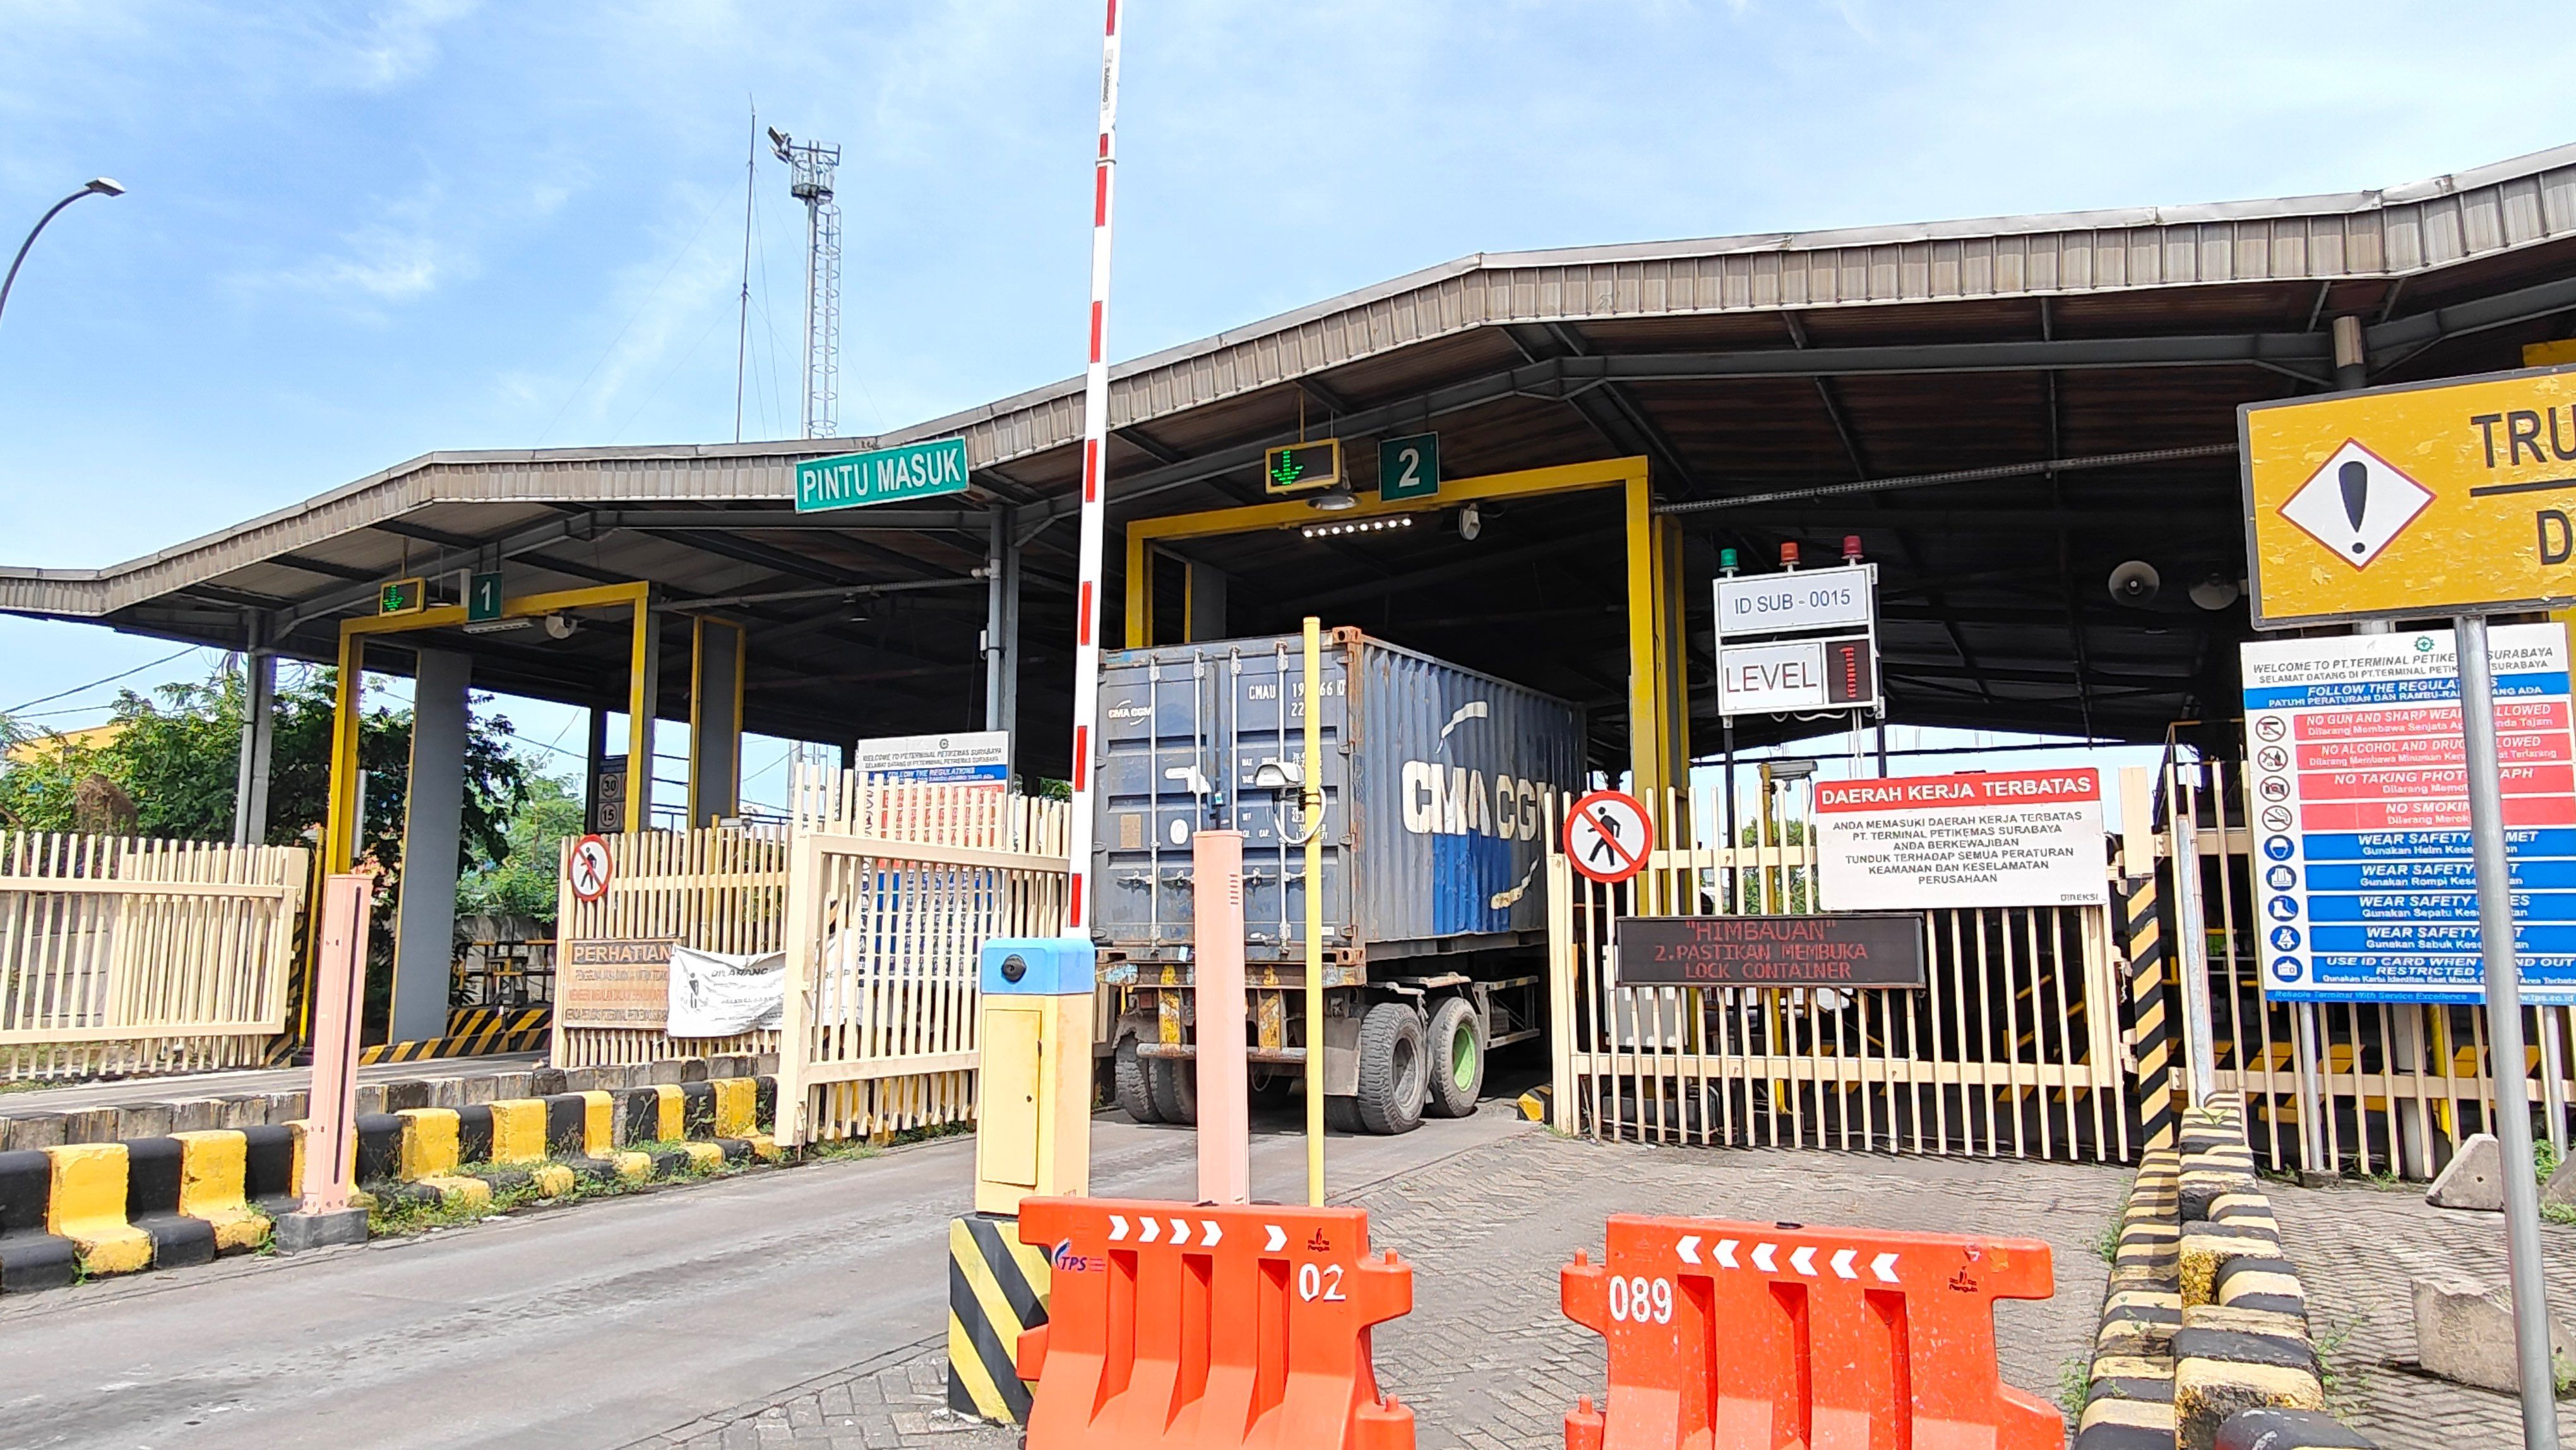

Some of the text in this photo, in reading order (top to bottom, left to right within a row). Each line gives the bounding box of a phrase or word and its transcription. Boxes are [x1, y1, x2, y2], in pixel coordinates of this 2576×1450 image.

[2471, 404, 2576, 468] TRU
[802, 448, 961, 503] PINTU MASUK
[1398, 448, 1420, 488] 2
[2536, 509, 2573, 565] D
[481, 581, 491, 611] 1
[1735, 597, 1751, 614] ID
[1756, 594, 1793, 612] SUB
[1810, 589, 1851, 608] 0015
[2253, 661, 2311, 673] WELCOME
[2313, 661, 2330, 670] TO
[2412, 652, 2455, 664] PETIKE
[2488, 647, 2553, 660] SURABAYA
[1726, 661, 1817, 693] LEVEL
[1839, 645, 1857, 698] 1
[2259, 673, 2304, 684] SELAMAT
[2306, 672, 2346, 681] DATANG
[2429, 665, 2459, 674] PETIK
[2491, 660, 2548, 671] SURABAYA
[1249, 684, 1277, 700] CMAU
[1292, 681, 1333, 697] 1966
[2307, 684, 2365, 697] FOLLOW
[2369, 683, 2396, 693] THE
[2269, 698, 2305, 707] PATUHI
[2374, 693, 2396, 702] DAN
[2399, 690, 2460, 700] RAMBU-RA
[1107, 705, 1152, 719] CMA CGM
[1291, 702, 1304, 717] 22
[2306, 704, 2551, 726] NO GUN AND SHARP WEA LLOWED
[2308, 726, 2350, 737] Dilarang
[2408, 724, 2447, 733] Senjata
[2520, 718, 2553, 728] Tajam
[2321, 745, 2339, 756] NO
[2340, 741, 2399, 755] ALCOHOL
[2401, 740, 2426, 752] AND
[2496, 736, 2541, 747] LOWED
[2309, 757, 2347, 767] Dilarang
[604, 779, 616, 792] 30
[2334, 774, 2357, 784] NO
[2361, 772, 2418, 784] TAKING
[1821, 777, 2091, 806] DAERAH KERJA TERBATAS
[2382, 785, 2428, 794] Dilarang
[1402, 760, 1557, 842] CMA CGM
[2386, 803, 2408, 813] NO
[603, 809, 614, 822] 15
[1833, 812, 2082, 831] ANDA MEMASUKI DAERAH KERJA TERBATAS
[2387, 814, 2470, 825] Dilarang Merok
[1853, 824, 2062, 841] PT. TERMINAL PETIKEMAS SURABAYA
[2358, 831, 2539, 846] WEAR SAFETY MET
[1893, 838, 2019, 851] ANDA BERKEWAJIBAN
[2362, 846, 2412, 856] Gunakan
[2414, 846, 2443, 855] Helm
[1846, 848, 2073, 864] TUNDUK TERHADAP SEMUA PERATURAN
[1868, 860, 2049, 875] KEAMANAN DAN KESELAMATAN
[2362, 863, 2474, 876] WEAR SAFETY
[1918, 873, 1997, 884] PERUSAHAAN
[2360, 877, 2408, 886] Gunakan
[2411, 877, 2448, 887] Rompi
[2060, 893, 2099, 902] DIREKSI
[2359, 896, 2405, 907] WEAR
[2409, 895, 2471, 906] SAFETY
[2362, 908, 2452, 918] Gunakan Sepatu
[1685, 920, 1837, 942] "HIMBAUAN"
[2367, 926, 2479, 938] WEAR SAFETY
[2366, 940, 2415, 949] Gunakan
[2418, 939, 2452, 949] Sabuk
[573, 944, 671, 962] PERHATIAN
[1781, 944, 1868, 961] MEMBUKA
[2327, 957, 2575, 967] USE ID CARD WHEN ND OUT
[1686, 962, 1851, 979] LOCK CONTAINER
[2375, 966, 2475, 976] RESTRICTED
[2355, 991, 2376, 999] With
[2379, 992, 2413, 1000] Service
[2416, 992, 2467, 1000] Excellence
[2520, 994, 2574, 1003] w.tps.co.id
[1061, 1257, 1088, 1271] TPS
[1298, 1262, 1347, 1302] 02
[1608, 1274, 1673, 1324] 089
